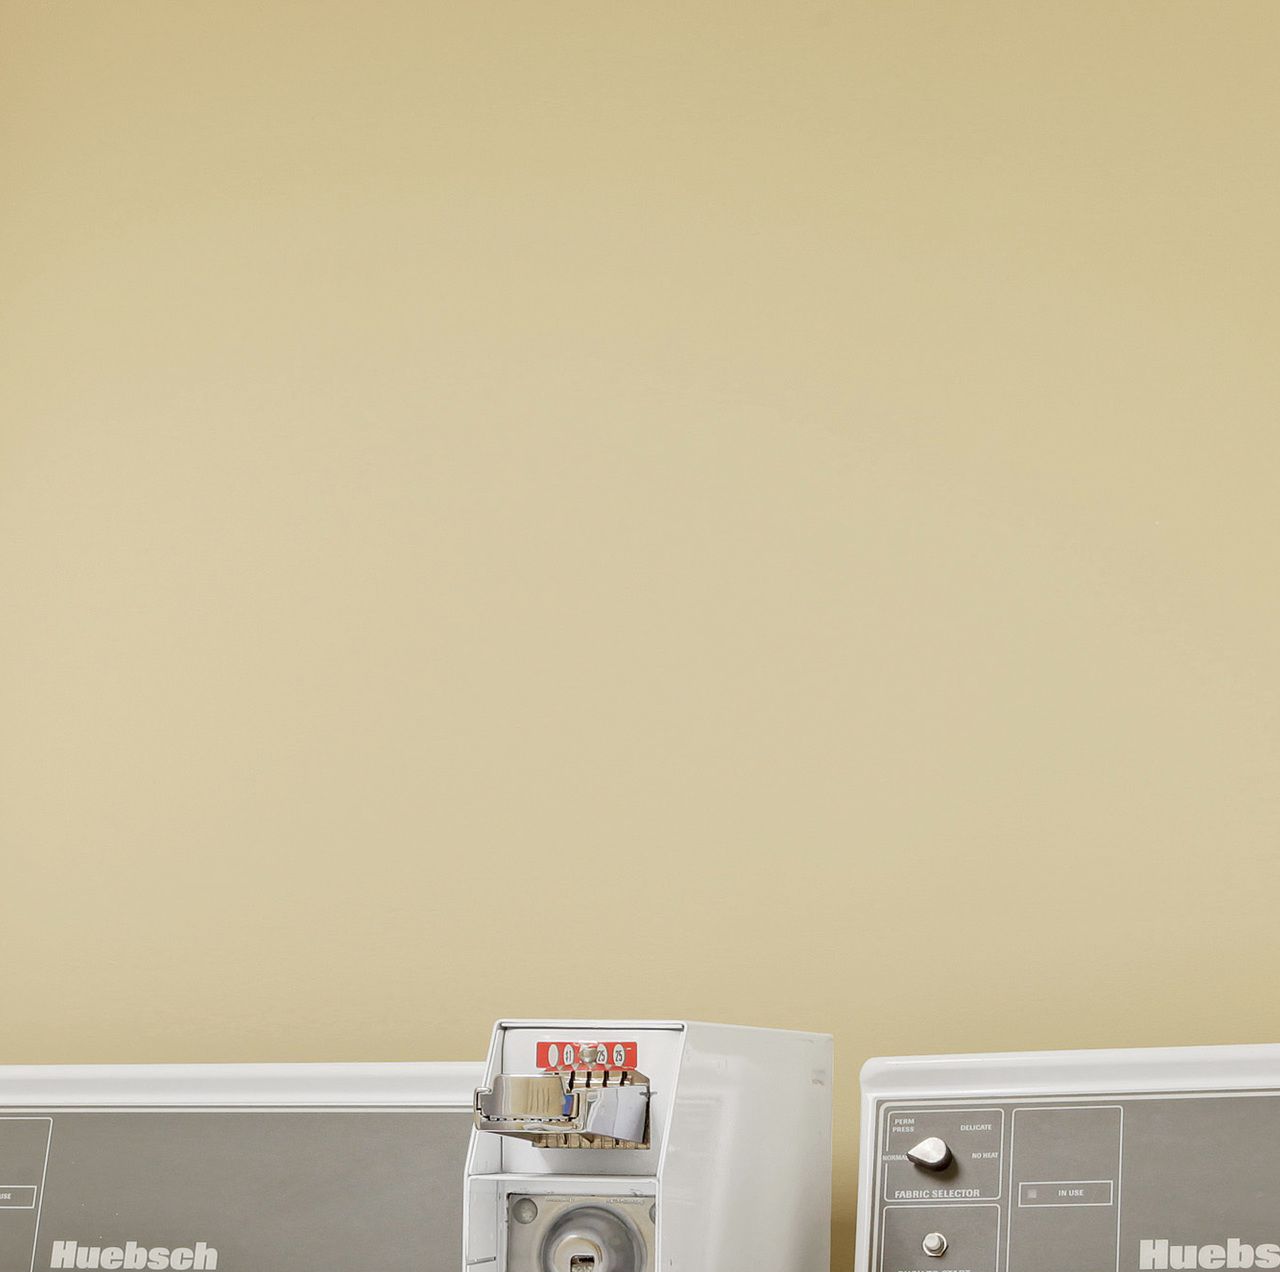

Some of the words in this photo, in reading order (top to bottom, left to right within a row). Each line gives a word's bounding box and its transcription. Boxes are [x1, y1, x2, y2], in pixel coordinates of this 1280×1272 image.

[615, 1050, 623, 1062] 25
[894, 1190, 930, 1199] FABRIC
[931, 1189, 980, 1198] SELECTOR
[1058, 1189, 1067, 1197] IN
[50, 1240, 219, 1271] Huebsch
